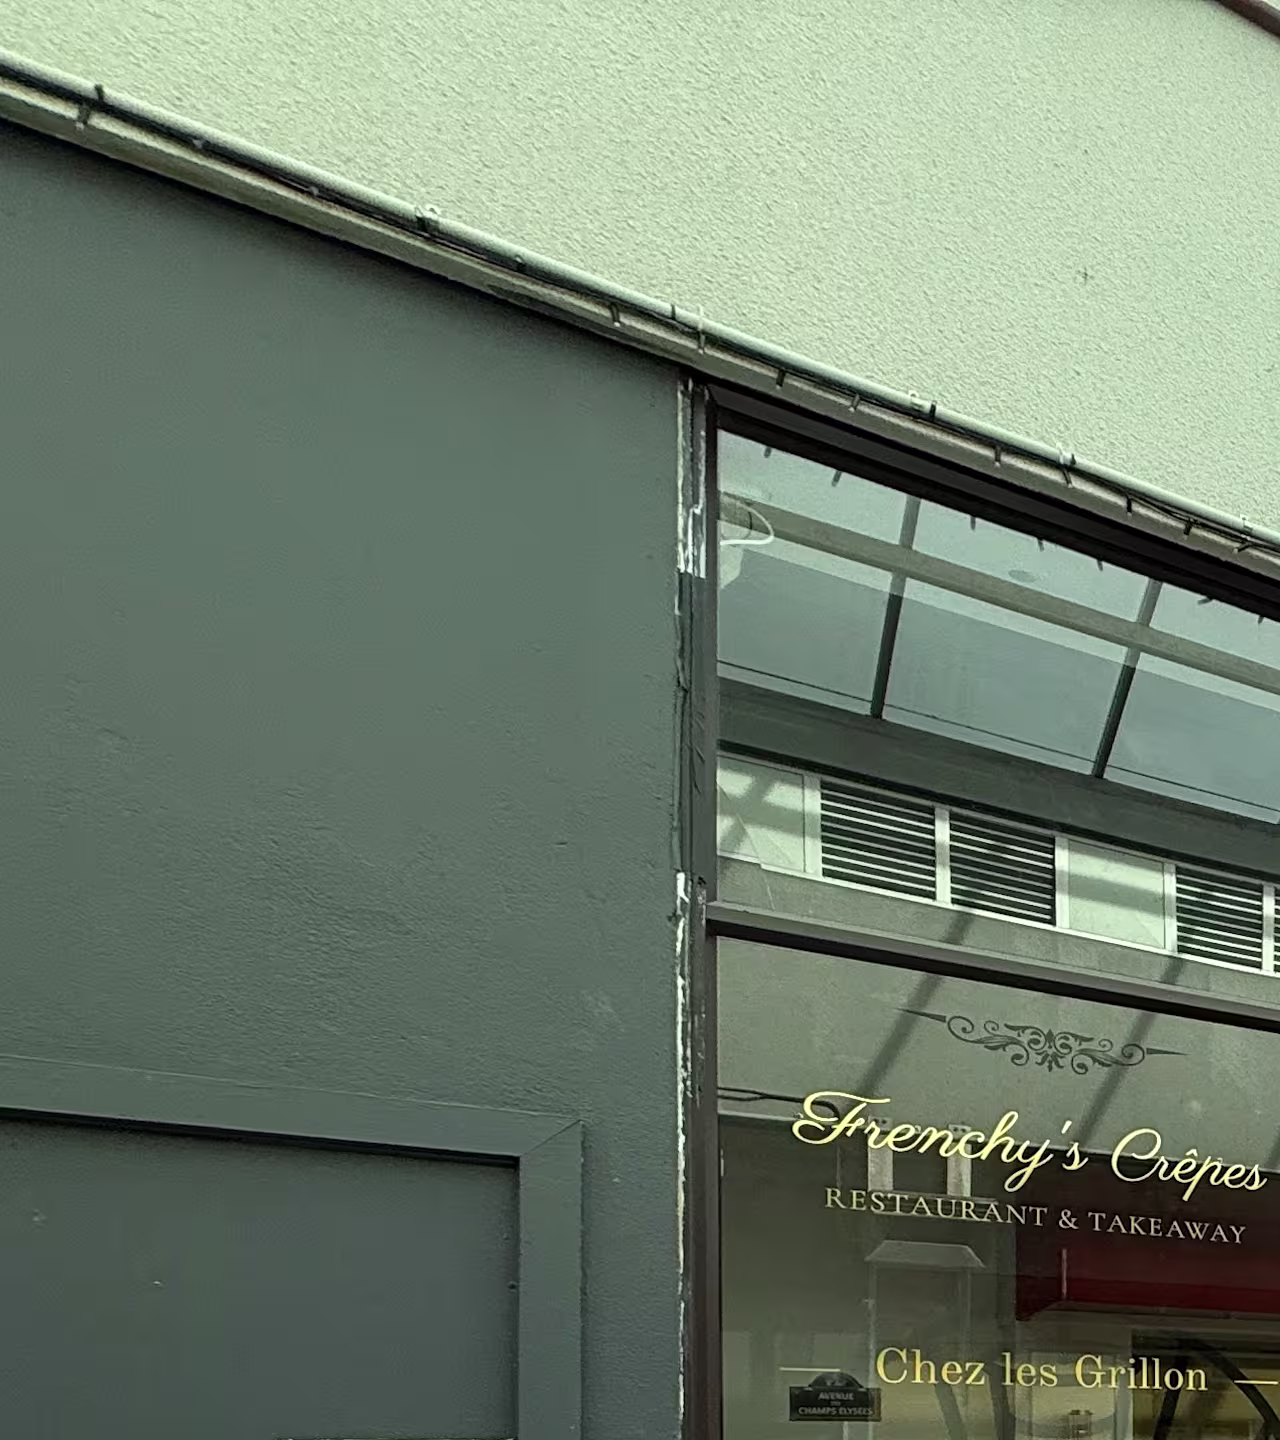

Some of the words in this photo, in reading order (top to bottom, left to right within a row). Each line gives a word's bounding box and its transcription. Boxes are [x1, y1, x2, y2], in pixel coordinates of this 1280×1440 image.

[792, 1091, 1088, 1192] Frenchy's
[1111, 1128, 1268, 1202] Crêpes
[824, 1187, 1048, 1226] RESTAURANT
[1058, 1208, 1079, 1230] &
[1088, 1212, 1246, 1244] TAKEAWAY
[876, 1347, 986, 1385] Chez
[1002, 1351, 1058, 1387] les
[1075, 1354, 1209, 1391] Grillon
[798, 1406, 838, 1415] CHAMPS
